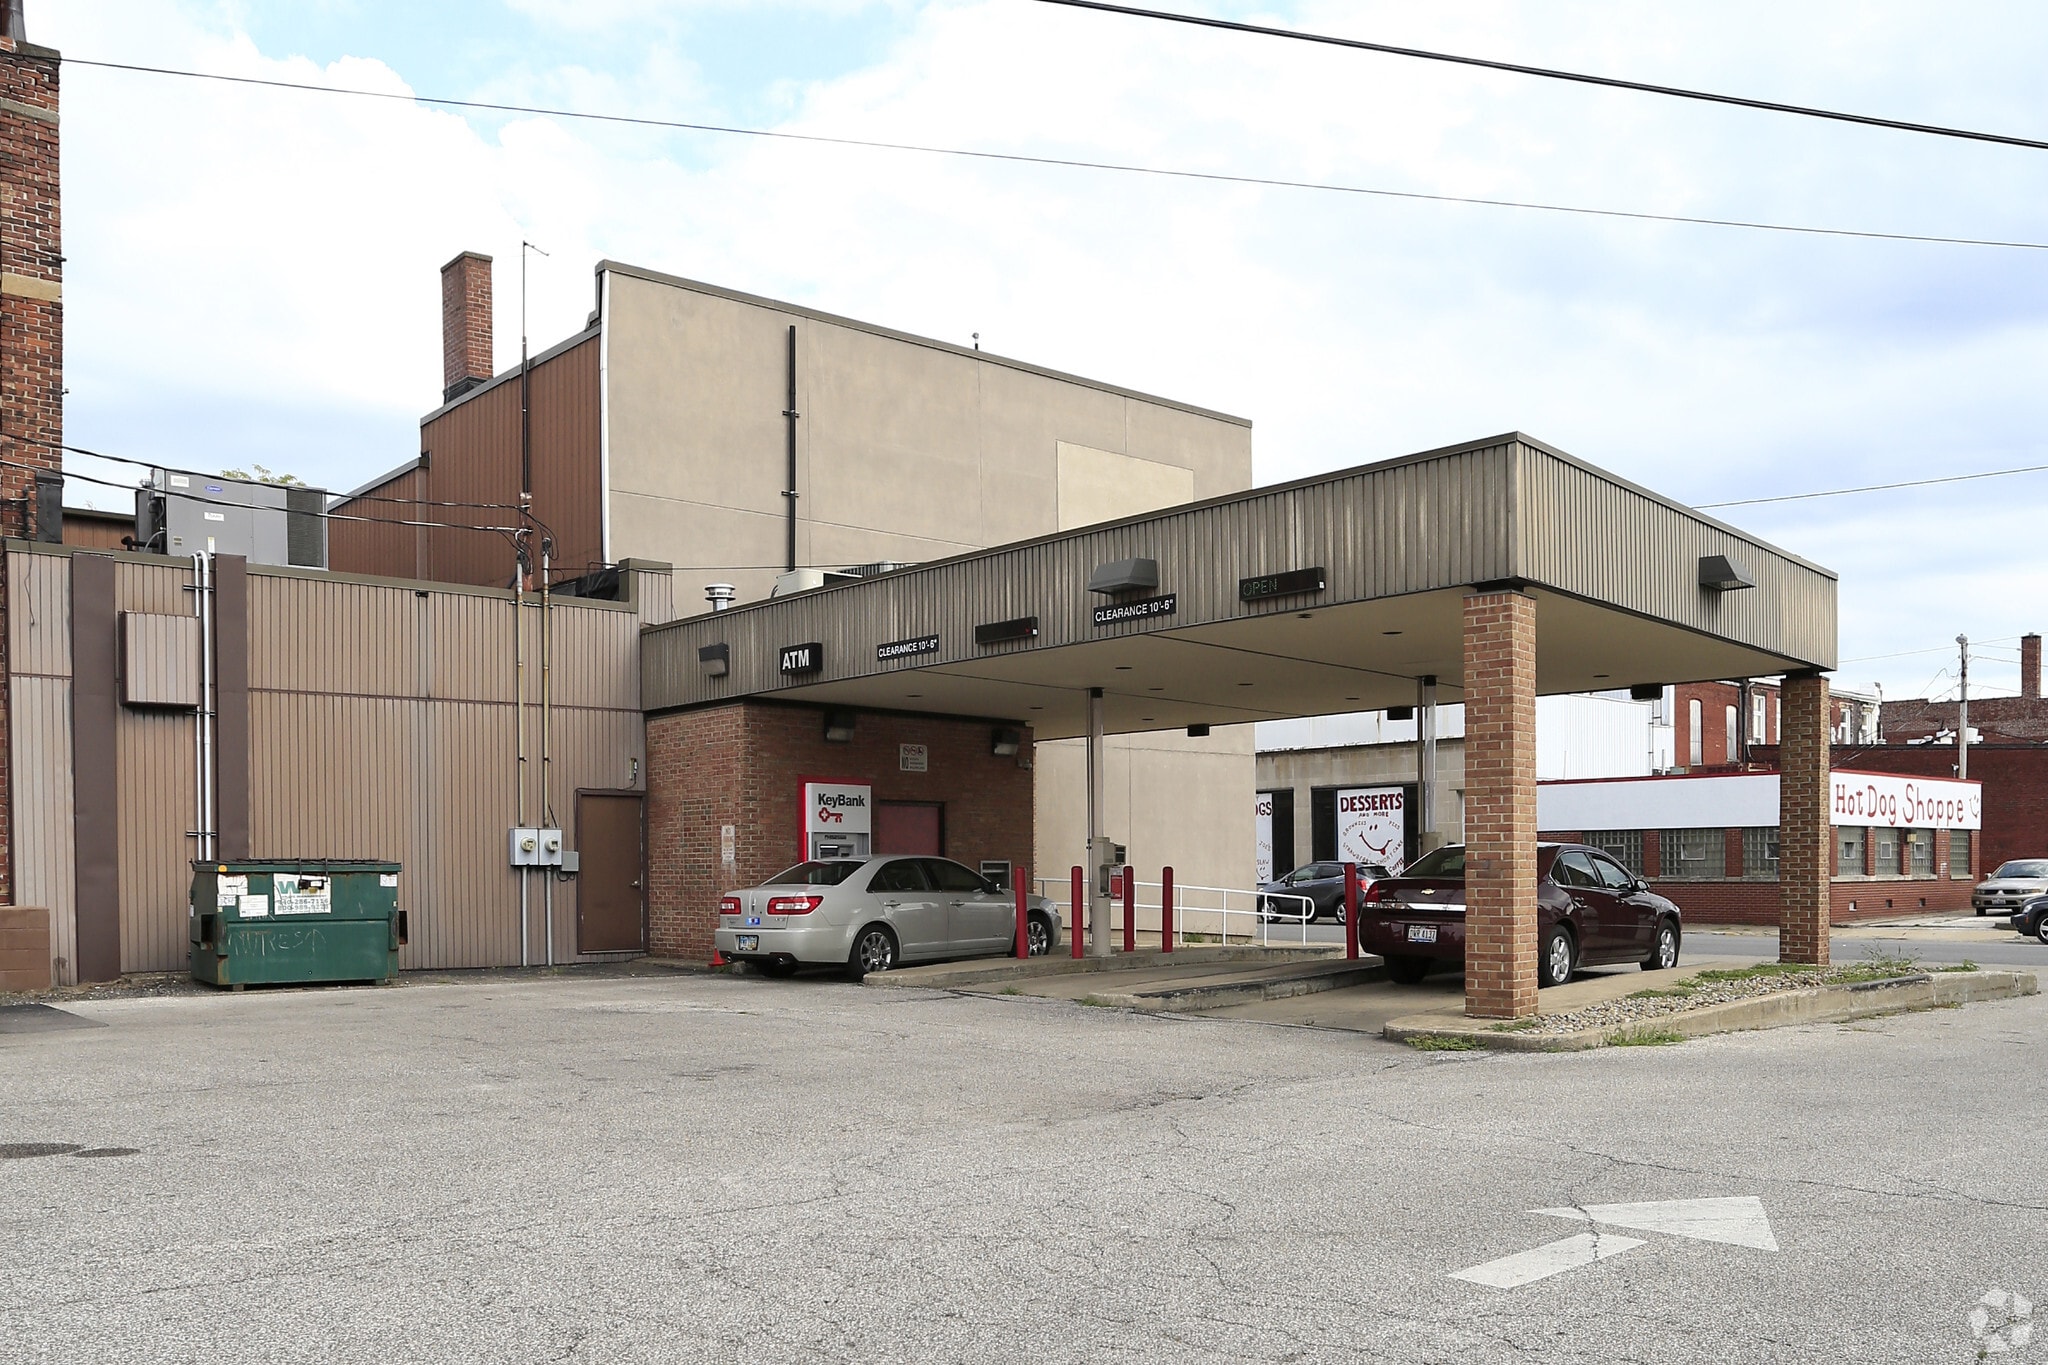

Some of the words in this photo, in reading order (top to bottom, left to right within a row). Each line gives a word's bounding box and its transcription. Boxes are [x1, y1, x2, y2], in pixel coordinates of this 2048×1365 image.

[1242, 578, 1278, 596] OPEN
[1095, 603, 1148, 622] CLEARANCE
[782, 648, 810, 670] ATM
[878, 642, 918, 658] CLEARANCE
[818, 793, 865, 808] KeyBank
[1255, 801, 1272, 817] GS
[1340, 792, 1403, 813] DESSERTS
[1835, 784, 1863, 816] Hot
[1867, 784, 1897, 826] Dog
[1902, 783, 1964, 827] Shoppe
